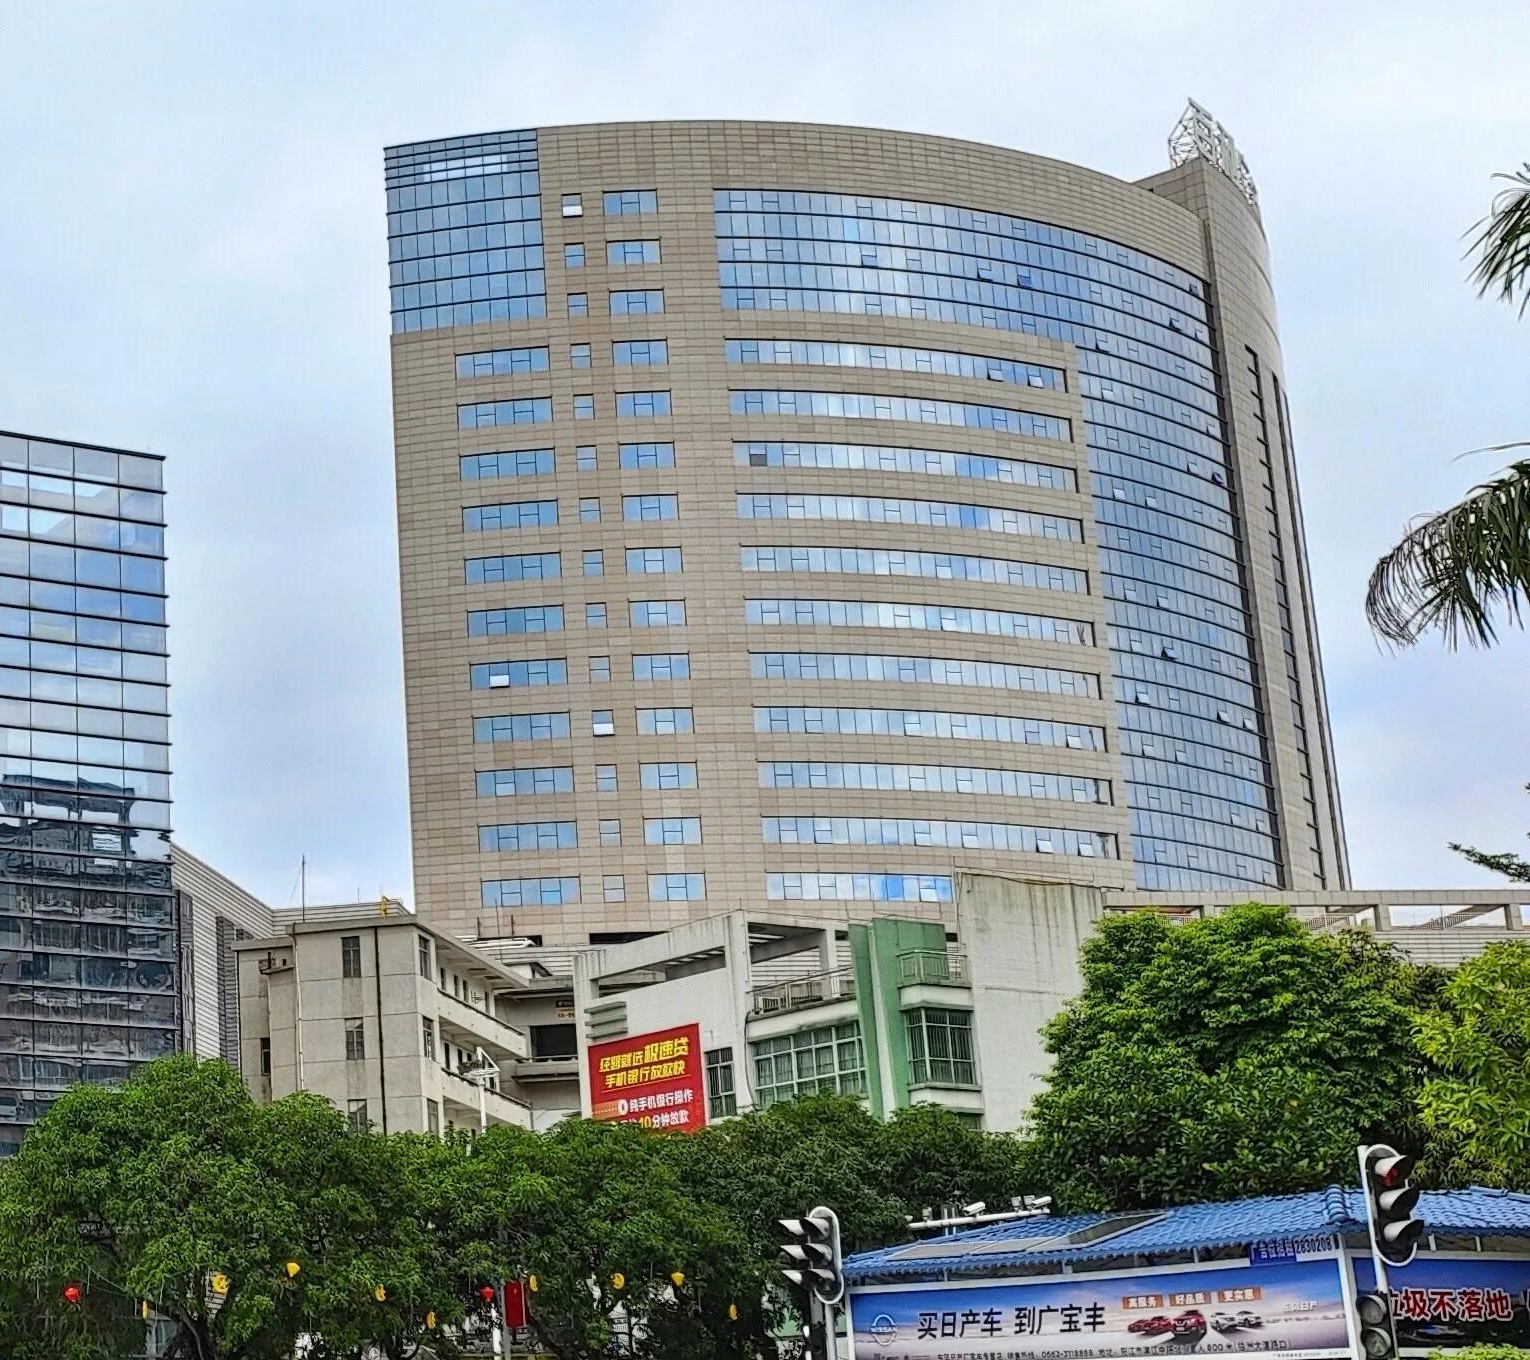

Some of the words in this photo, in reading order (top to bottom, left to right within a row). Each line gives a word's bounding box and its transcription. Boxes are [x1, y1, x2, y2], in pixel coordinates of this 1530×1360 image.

[605, 1060, 686, 1088] 手机银行放款快
[629, 1088, 694, 1113] 纯手机银行操作
[917, 1308, 1003, 1340] 买日产车
[1013, 1302, 1106, 1336] 到广宝丰
